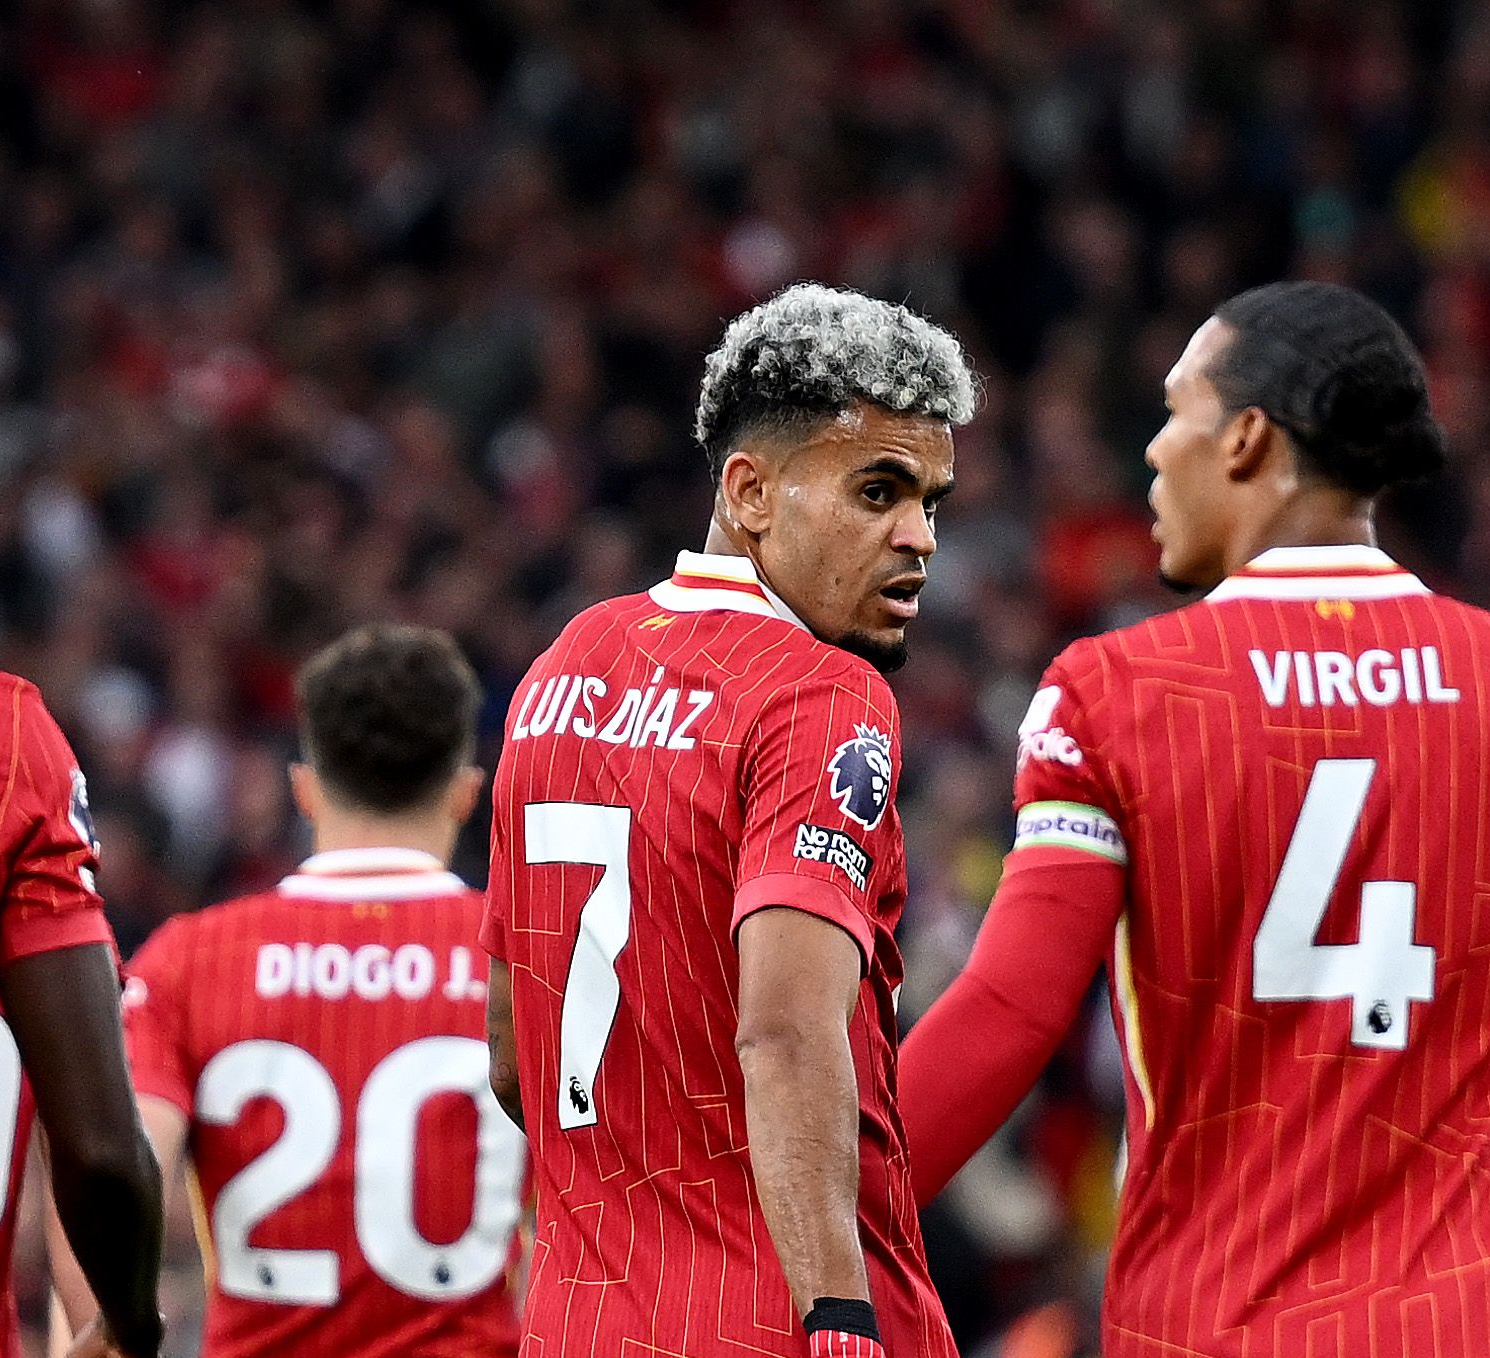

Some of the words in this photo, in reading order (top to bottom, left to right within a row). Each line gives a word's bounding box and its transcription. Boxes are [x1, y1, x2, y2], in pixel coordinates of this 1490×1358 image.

[1248, 645, 1460, 707] VIRGIL
[510, 672, 607, 743] LUIS
[598, 665, 715, 751] DÍAZ
[793, 840, 826, 861] for
[796, 824, 829, 847] No
[831, 833, 867, 873] room
[1017, 815, 1118, 845] aptain
[1252, 757, 1436, 1051] 4
[254, 942, 436, 1001] DIOGO
[442, 945, 487, 1001] J.
[523, 800, 632, 1131] 7
[194, 1036, 529, 1306] 20
